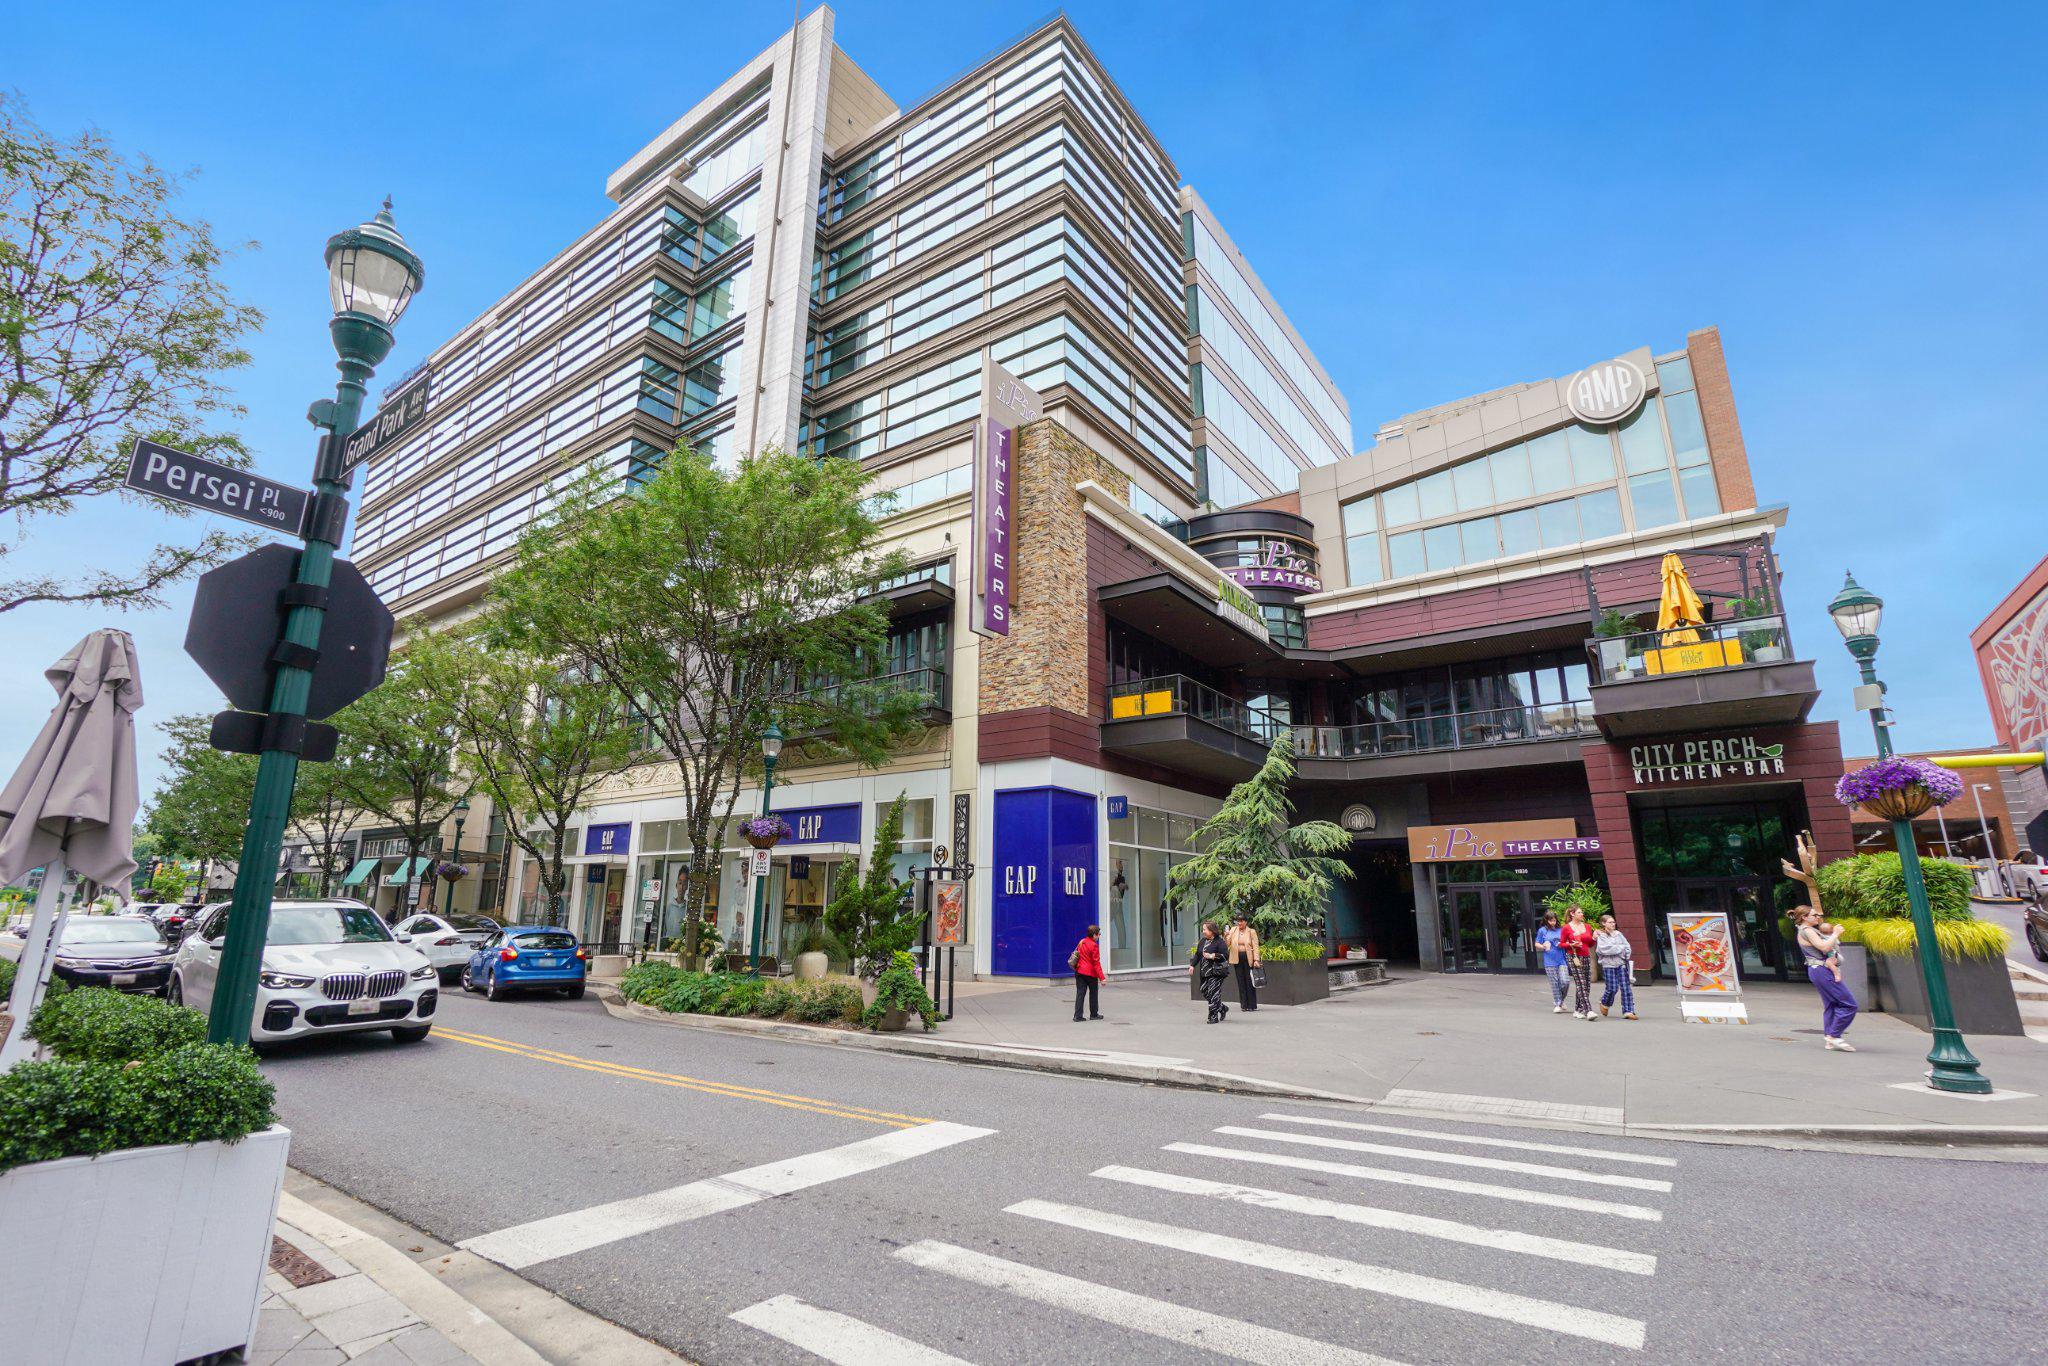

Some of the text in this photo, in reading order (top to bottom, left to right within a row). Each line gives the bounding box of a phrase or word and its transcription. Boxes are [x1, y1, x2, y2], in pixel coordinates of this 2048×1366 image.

[996, 380, 1037, 421] iPic
[1577, 365, 1632, 412] AMP
[345, 419, 380, 466] Grand
[379, 399, 407, 442] Park
[143, 452, 281, 511] Persei Pl
[993, 431, 1006, 621] THEATERS
[1247, 540, 1308, 573] iPic
[1228, 570, 1321, 590] THEATERS
[1630, 736, 1757, 767] CITY PERCH
[1633, 763, 1722, 784] KITCHEN
[1744, 758, 1785, 776] BAR
[1110, 802, 1123, 813] GAP
[1351, 814, 1366, 828] AMP
[602, 830, 614, 845] GAP
[799, 815, 822, 839] GAP
[1424, 827, 1498, 859] iPic
[1506, 839, 1600, 852] THEATERS
[1005, 865, 1036, 895] GAP
[1064, 866, 1086, 896] GAP
